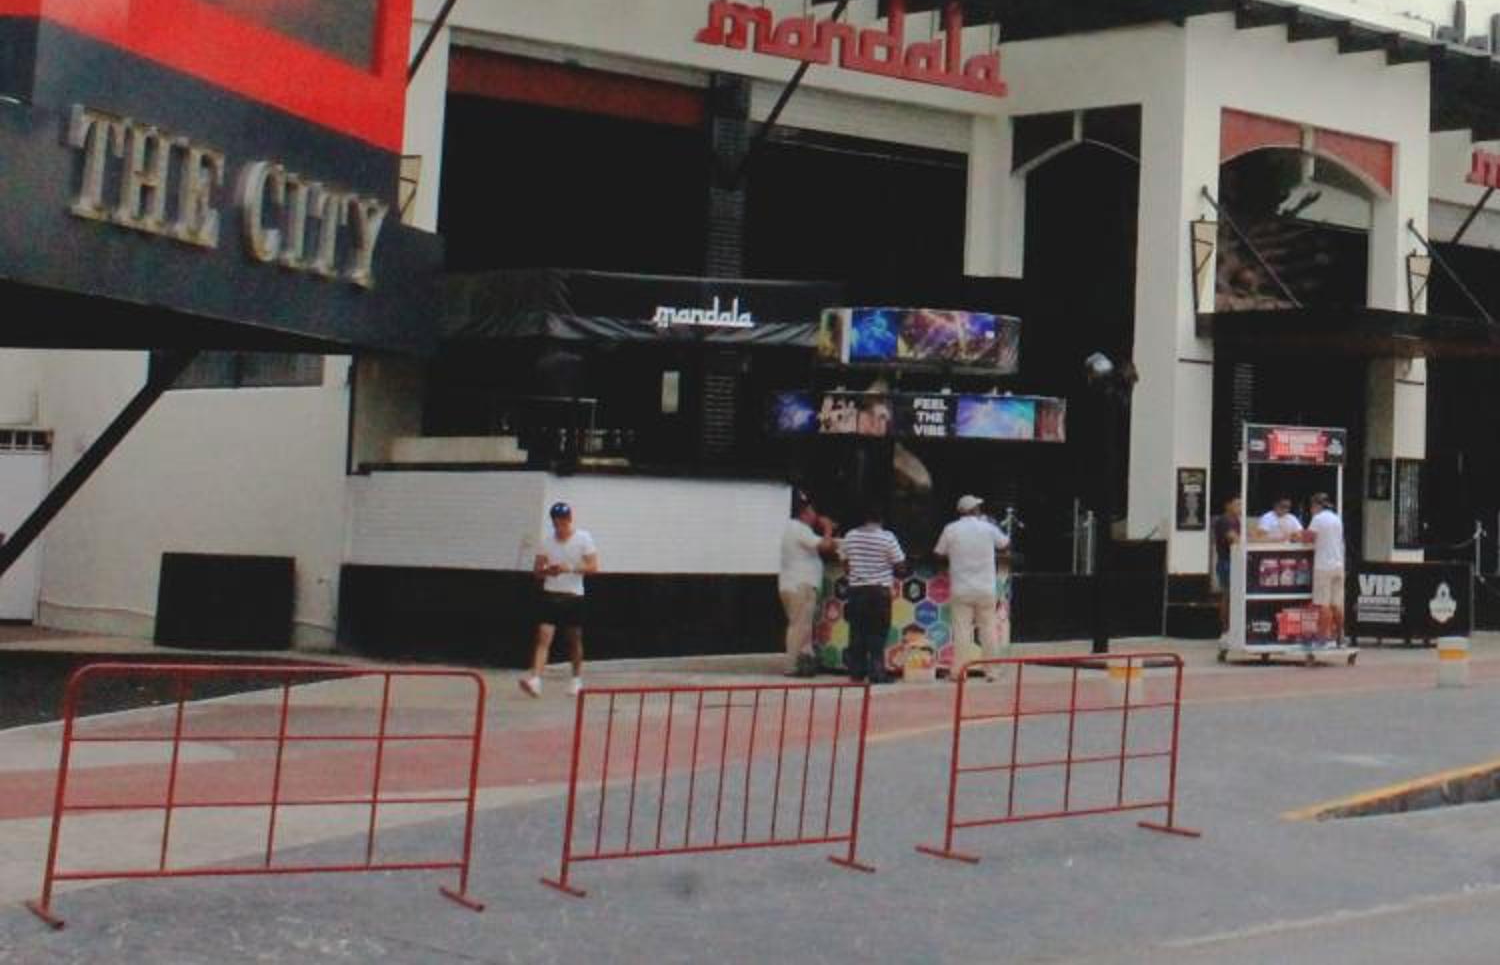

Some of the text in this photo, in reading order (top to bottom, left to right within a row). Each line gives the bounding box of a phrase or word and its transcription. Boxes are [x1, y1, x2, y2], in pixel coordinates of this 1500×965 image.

[66, 103, 225, 249] THE
[238, 157, 389, 289] CITY
[651, 295, 755, 328] mandala
[912, 397, 948, 411] FEEL
[915, 411, 945, 424] THE
[1358, 574, 1402, 596] VIP
